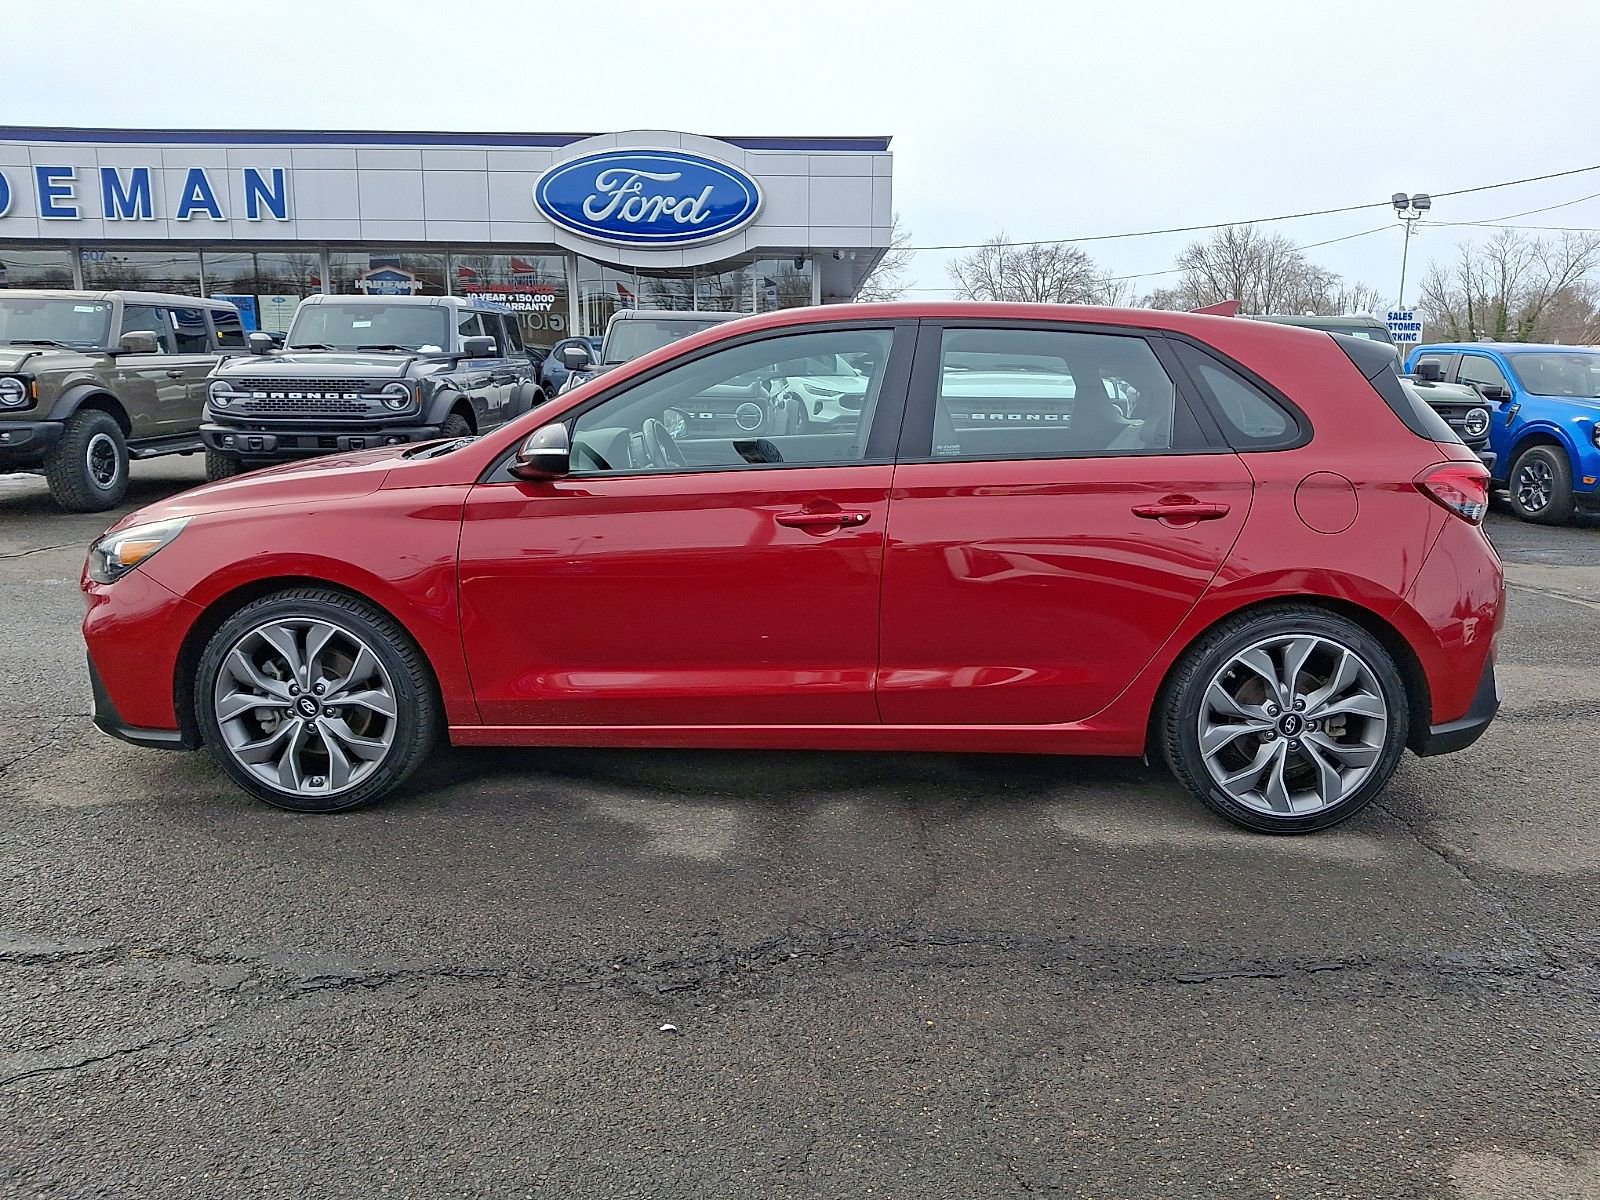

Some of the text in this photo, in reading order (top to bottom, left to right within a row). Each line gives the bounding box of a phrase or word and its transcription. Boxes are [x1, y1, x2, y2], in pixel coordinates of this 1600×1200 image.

[0, 165, 290, 222] EMAN
[582, 168, 715, 224] Ford
[515, 293, 555, 304] 150,000
[1387, 312, 1413, 321] SALES
[1386, 322, 1421, 331] STOMER
[1392, 333, 1417, 341] RKING
